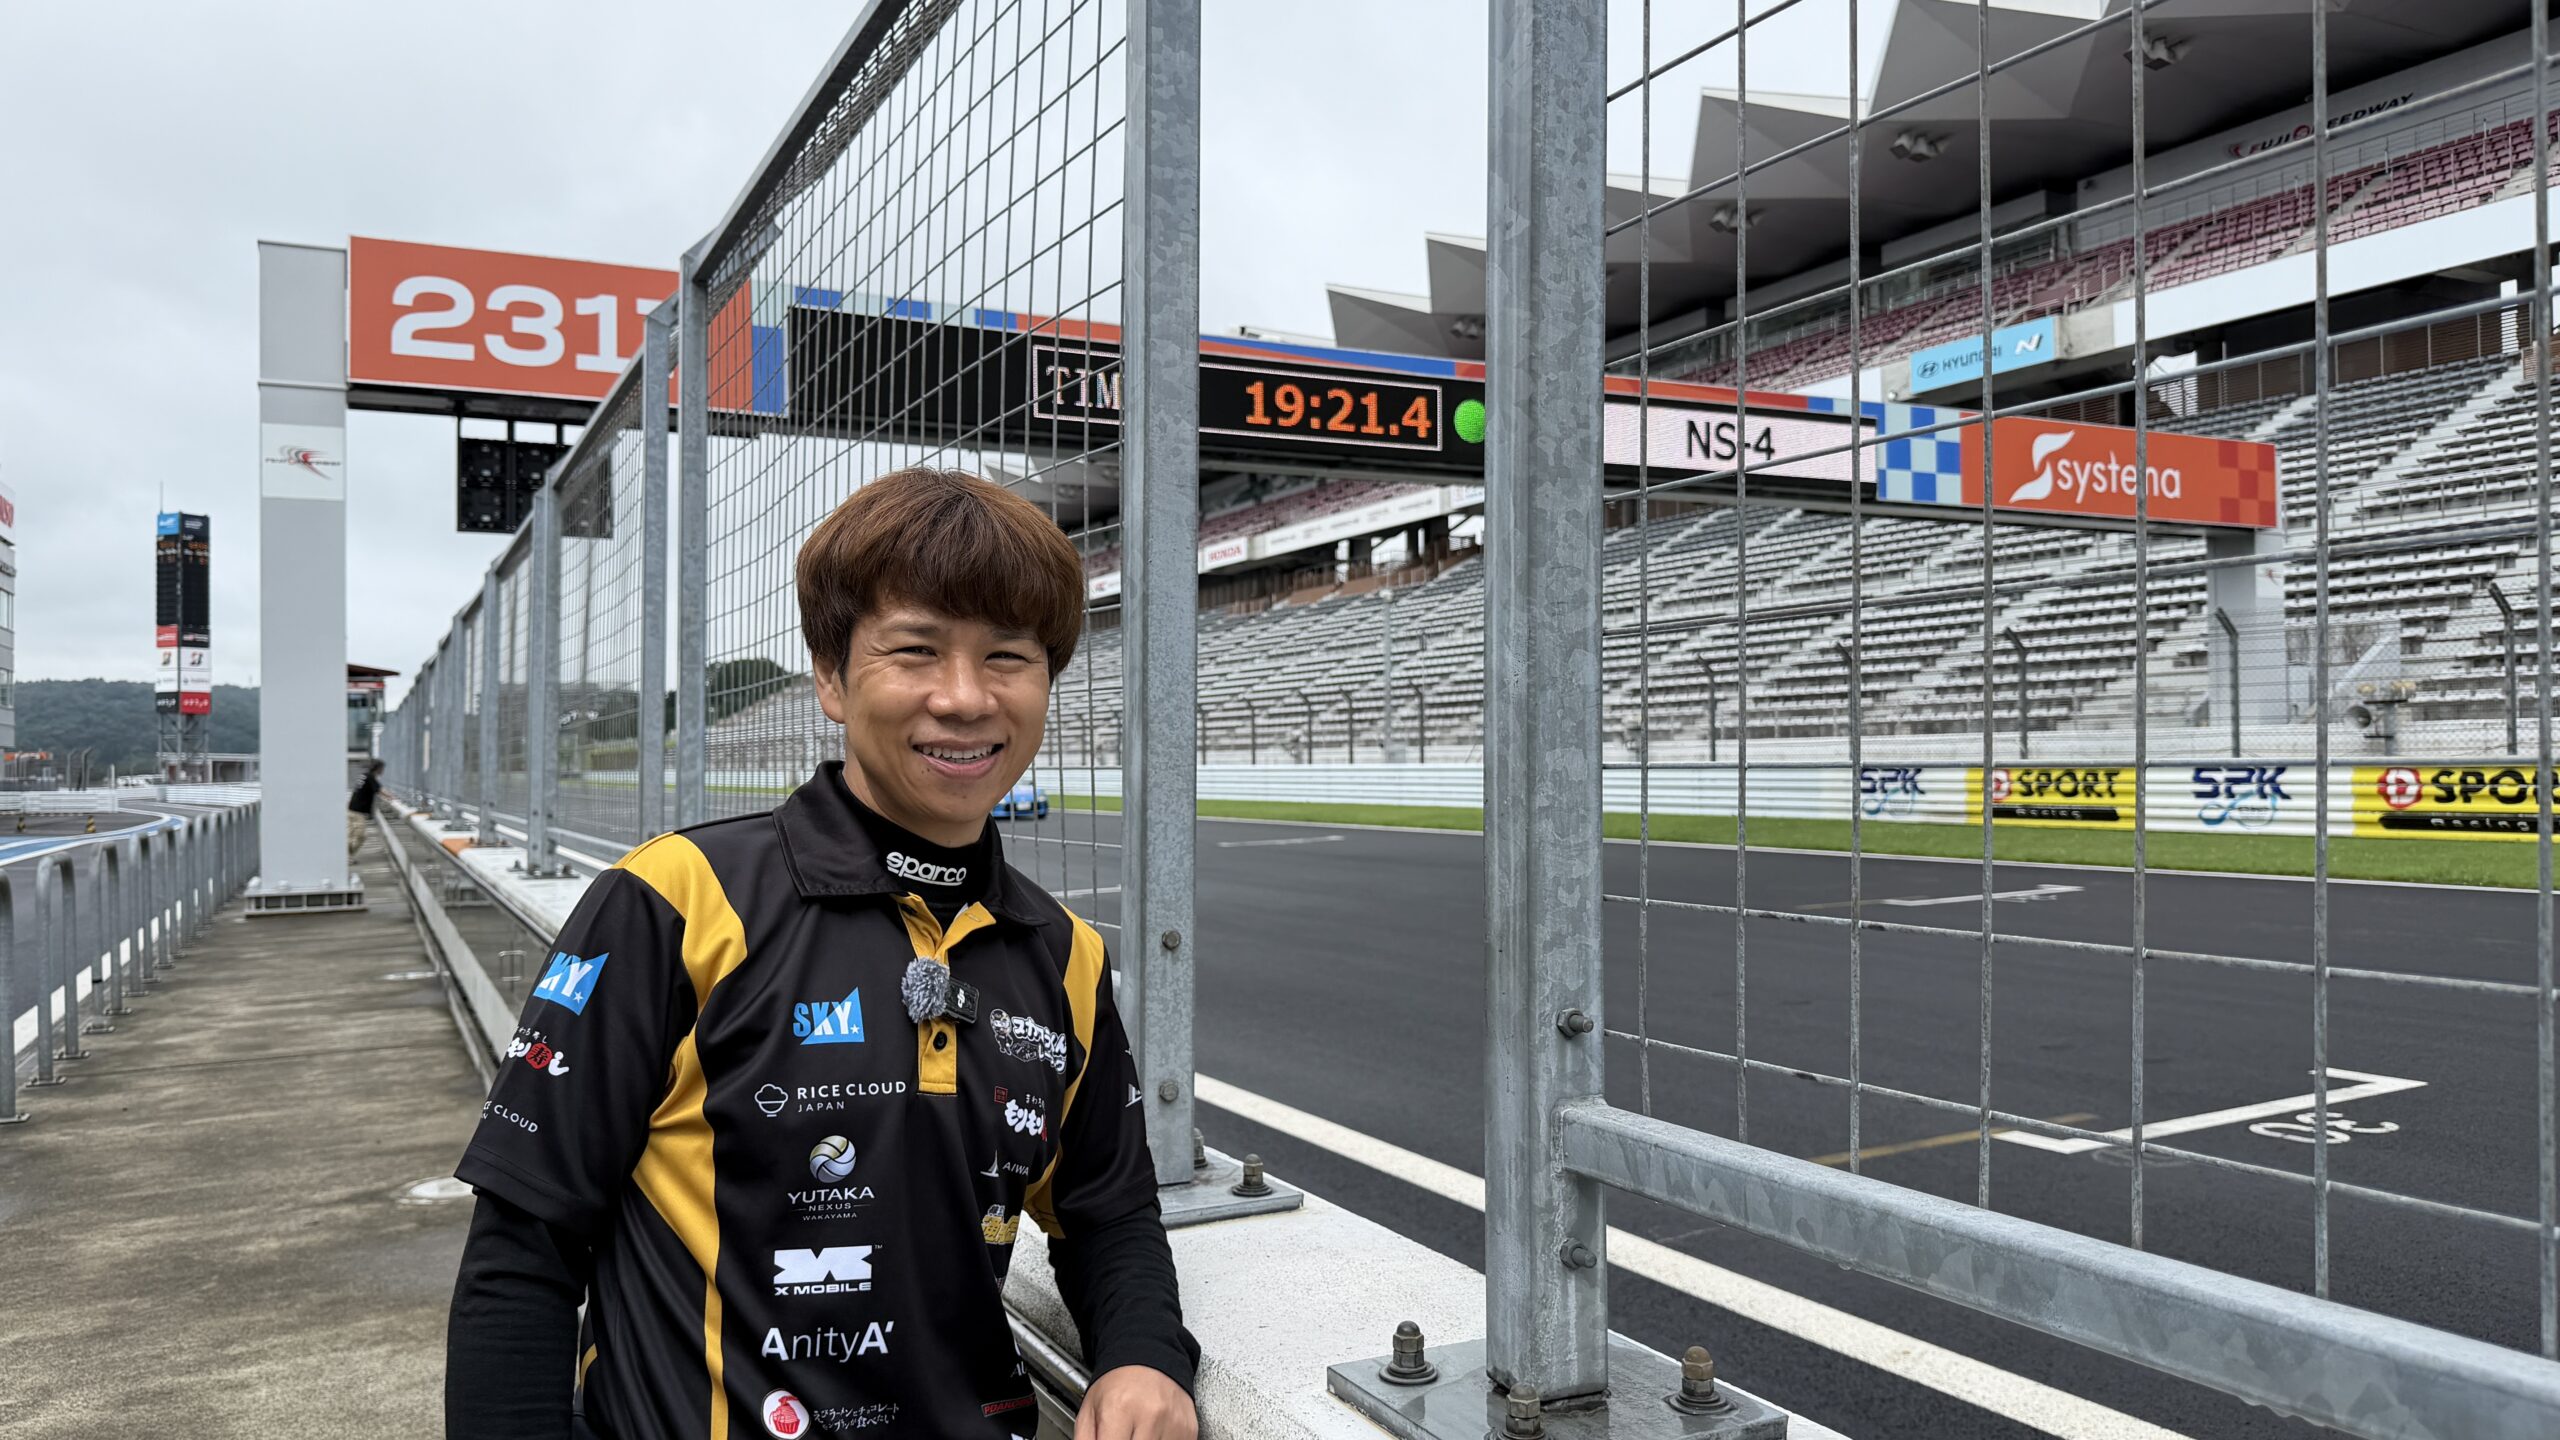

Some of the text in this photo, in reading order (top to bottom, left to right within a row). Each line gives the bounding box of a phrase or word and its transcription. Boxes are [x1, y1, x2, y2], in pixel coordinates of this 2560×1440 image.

[390, 274, 664, 375] 231
[1045, 364, 1432, 439] TIM 19:21.4
[1687, 420, 1775, 460] NS-4
[2017, 768, 2119, 798] SPORT
[2192, 766, 2292, 799] SPK
[886, 851, 967, 885] sparco
[797, 1081, 907, 1100] RICE CLOUD
[493, 1104, 539, 1133] CLOUD
[797, 1101, 846, 1113] JAPAN
[787, 1186, 876, 1205] YUTAKA
[808, 1202, 852, 1212] NEXUS
[802, 1212, 858, 1221] WAKAYAMA
[773, 1281, 872, 1297] X MOBILE
